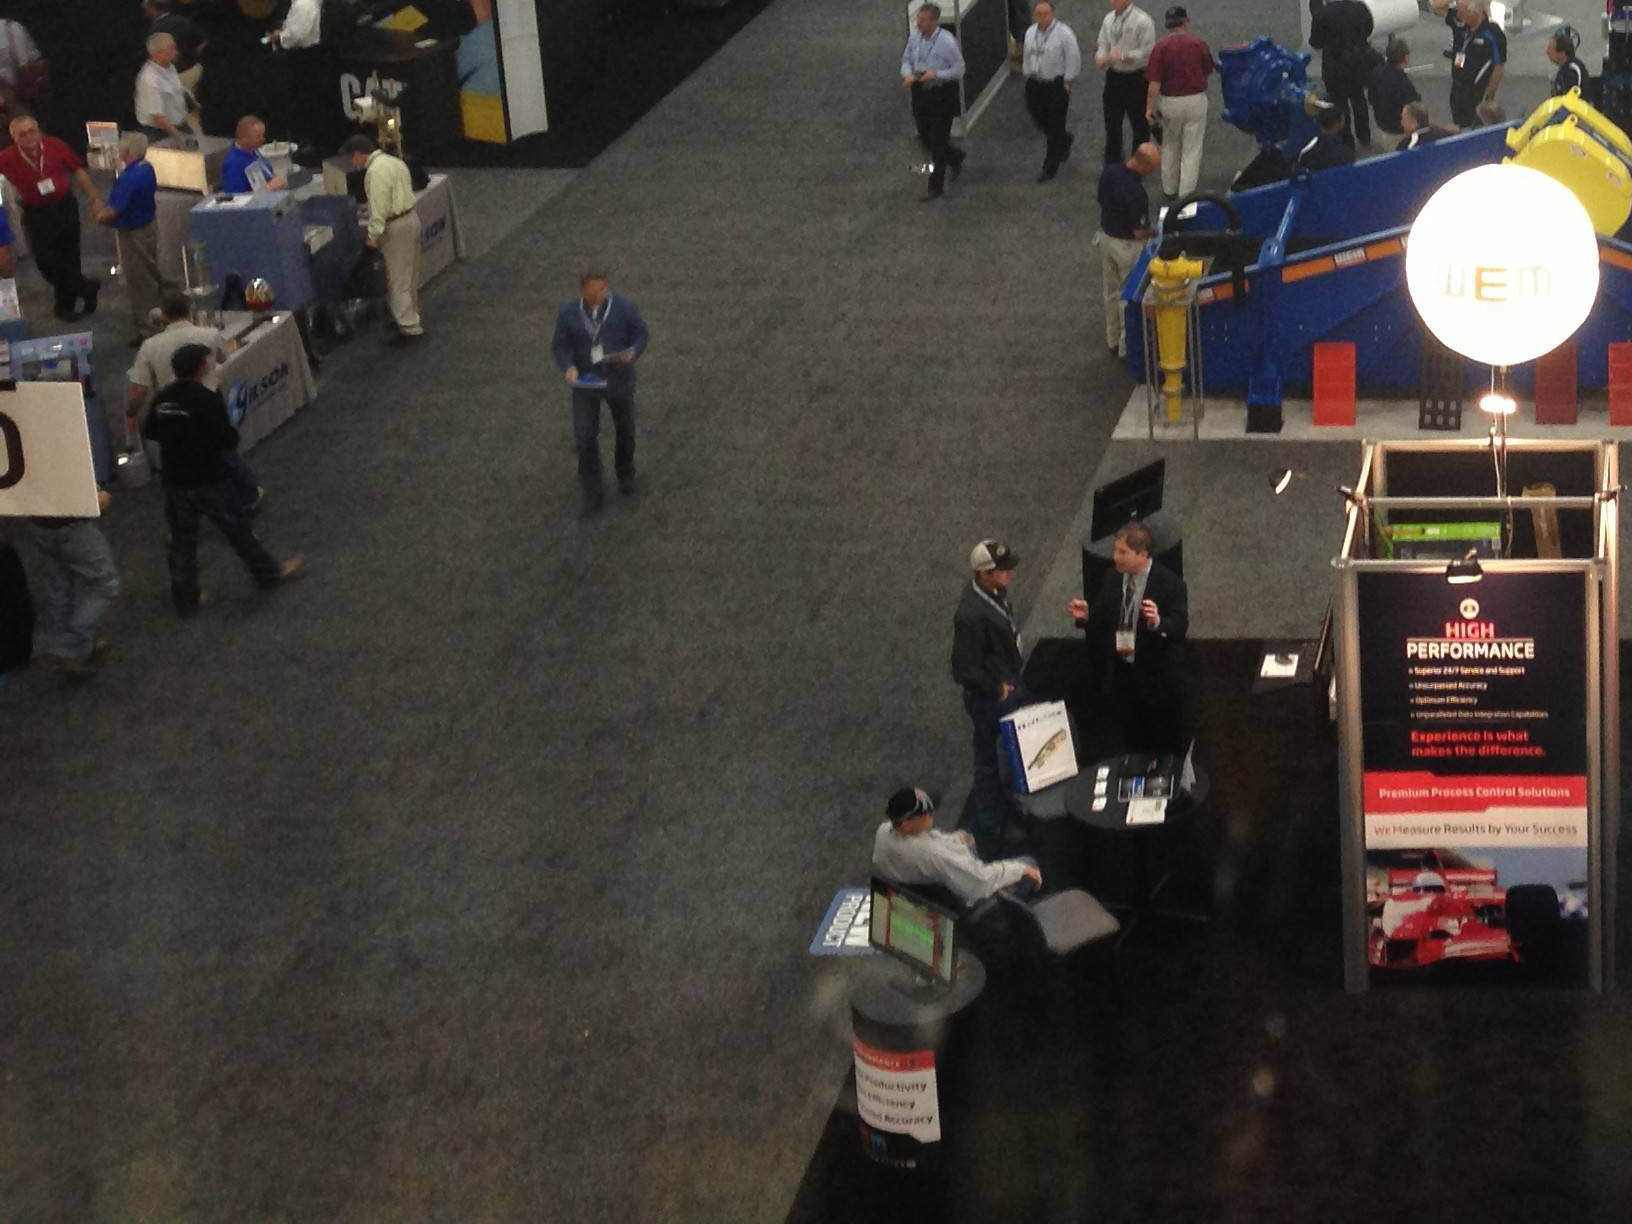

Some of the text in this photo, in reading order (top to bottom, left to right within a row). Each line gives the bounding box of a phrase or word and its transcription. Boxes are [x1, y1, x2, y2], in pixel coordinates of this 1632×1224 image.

[1445, 622, 1495, 639] HIGH
[1406, 642, 1535, 660] PERFORMANCE
[1414, 666, 1442, 676] Superior
[1485, 666, 1498, 675] and
[1498, 666, 1526, 676] Support
[1410, 730, 1529, 743] Experience is what
[1411, 744, 1546, 757] makes the difference.
[1378, 786, 1571, 800] Premium Process Control Solutions
[1392, 824, 1441, 836] Measure
[1443, 824, 1485, 835] Results
[1487, 823, 1501, 836] by
[1504, 823, 1530, 834] Your
[1532, 823, 1578, 835] Success
